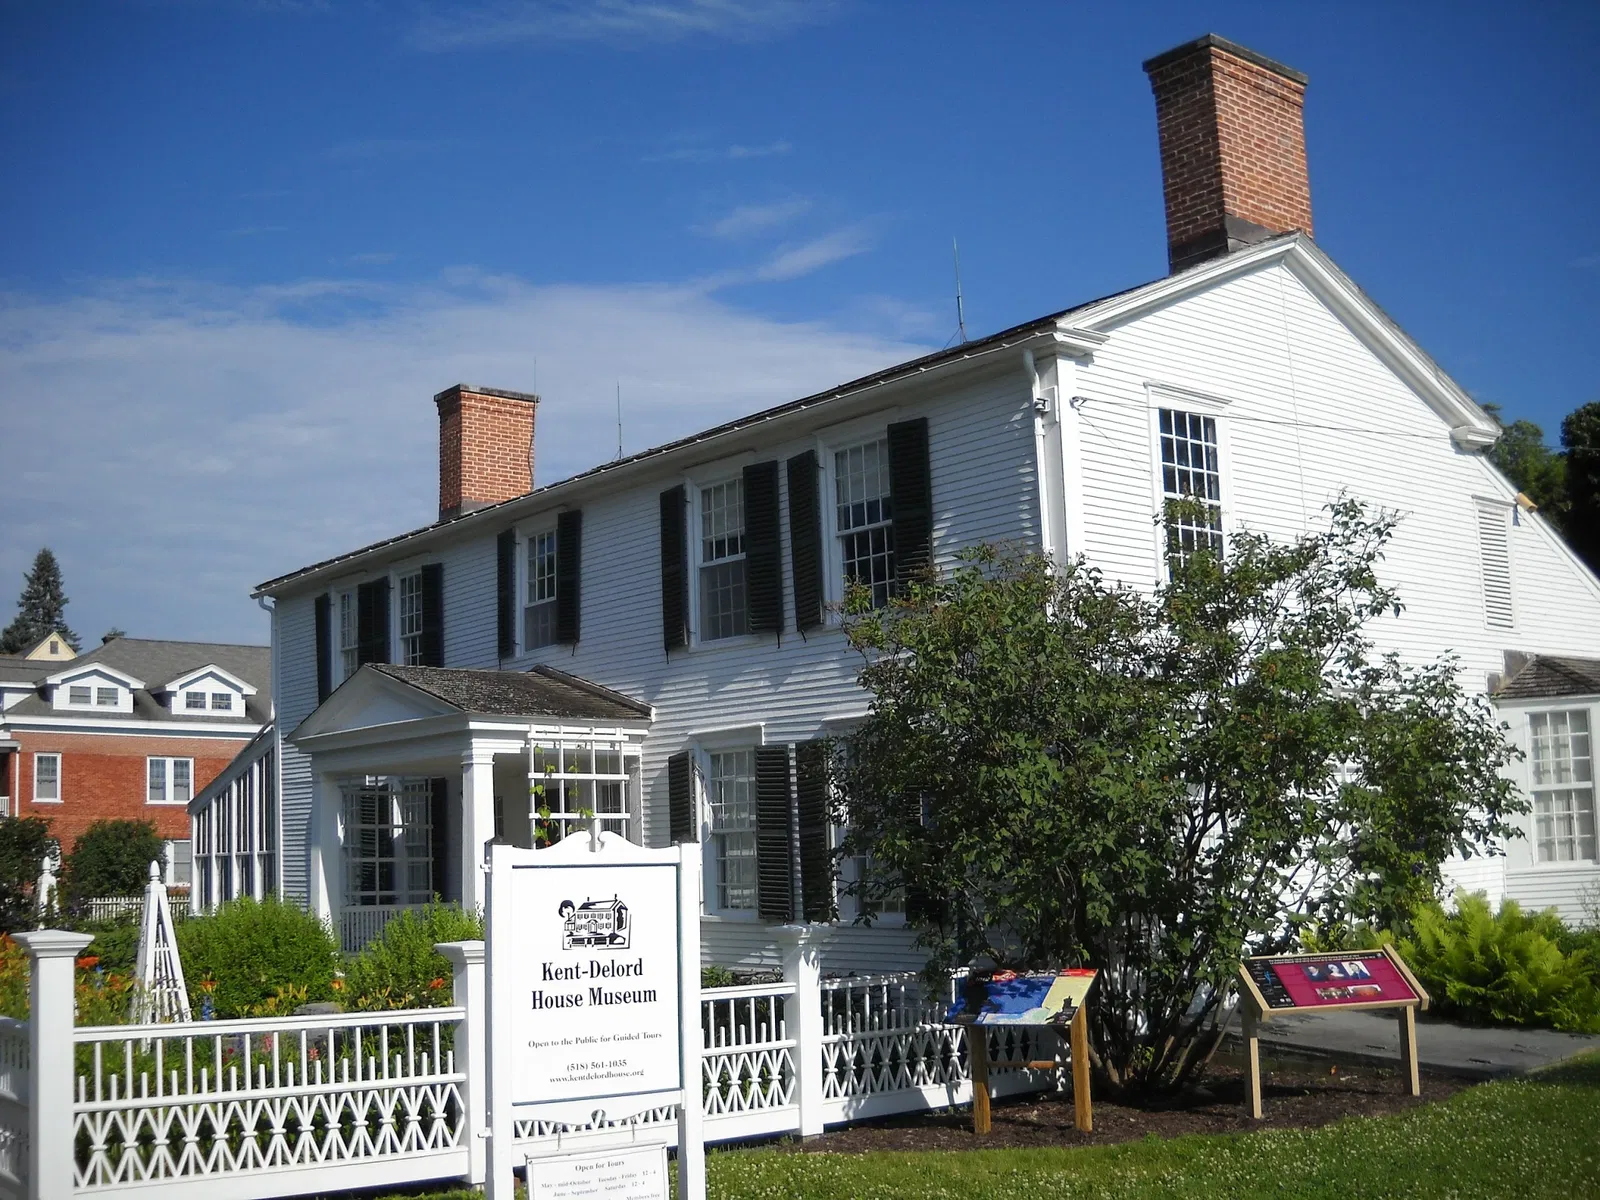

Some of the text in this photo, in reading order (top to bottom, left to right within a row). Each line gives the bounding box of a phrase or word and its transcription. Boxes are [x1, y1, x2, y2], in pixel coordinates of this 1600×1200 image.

[542, 958, 643, 982] Kent-Delord
[532, 986, 657, 1010] House Museum
[528, 1040, 549, 1049] Open
[576, 1036, 598, 1044] Public
[613, 1032, 640, 1042] Guided
[642, 1032, 662, 1040] Tours
[566, 1059, 628, 1072] (518) 561-1035
[550, 1069, 644, 1083] www.kentdelordhouse.org
[575, 1164, 594, 1172] Open
